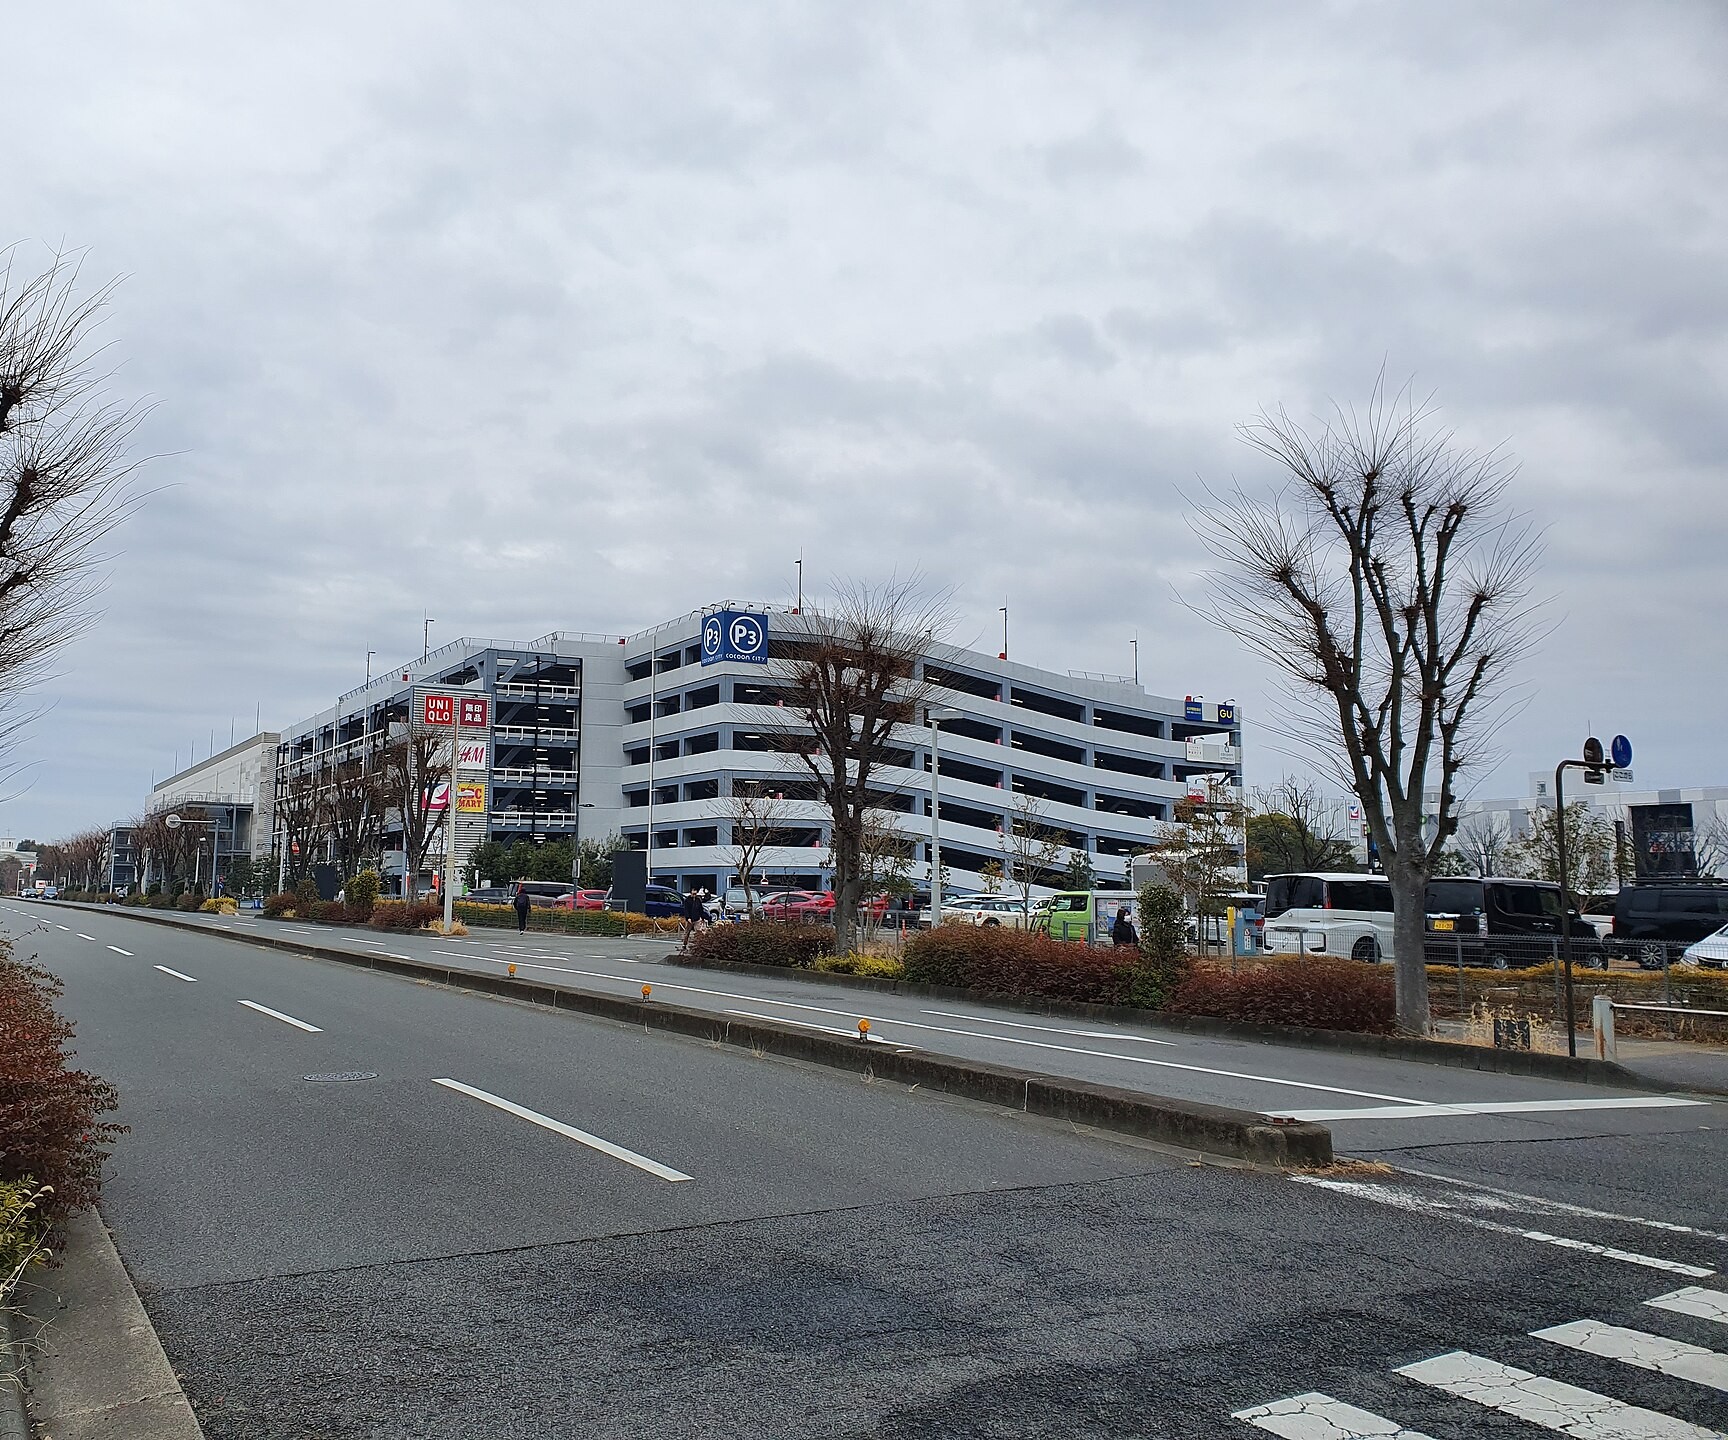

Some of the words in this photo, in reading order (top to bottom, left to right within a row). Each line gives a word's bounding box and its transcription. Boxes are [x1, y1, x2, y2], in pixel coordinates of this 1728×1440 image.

[706, 628, 719, 647] P3
[734, 625, 756, 645] P3
[428, 698, 449, 709] UNI
[465, 703, 483, 713] 無印
[428, 711, 450, 722] QLO
[464, 712, 482, 723] 良品
[1219, 708, 1233, 719] GU
[459, 746, 485, 764] H&M
[458, 799, 482, 808] MART
